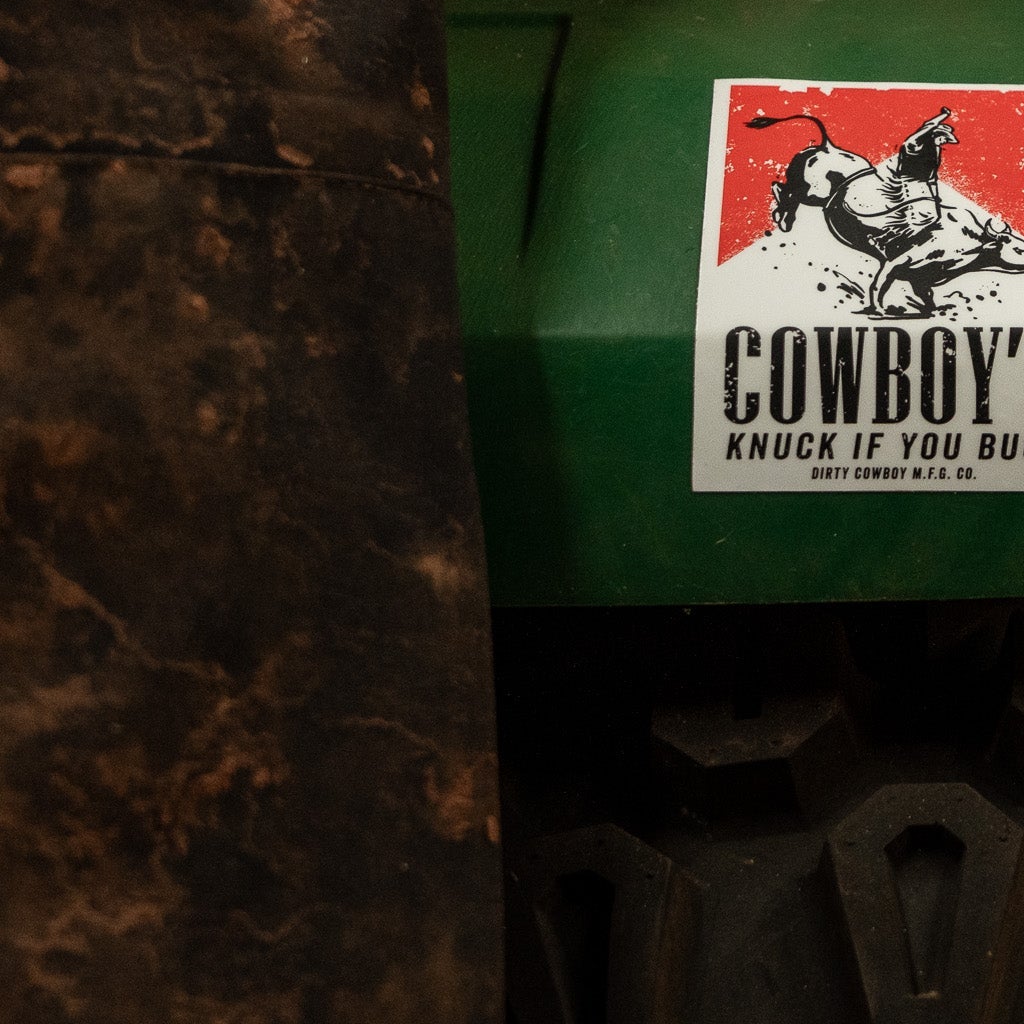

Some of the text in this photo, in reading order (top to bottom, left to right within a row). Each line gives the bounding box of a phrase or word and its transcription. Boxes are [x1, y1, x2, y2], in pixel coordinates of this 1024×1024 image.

[726, 432, 837, 460] KNUCK
[853, 432, 884, 460] IF
[901, 432, 961, 460] YOU
[811, 466, 848, 480] DIRTY
[854, 466, 907, 480] COWBOY
[957, 466, 977, 480] CO.
